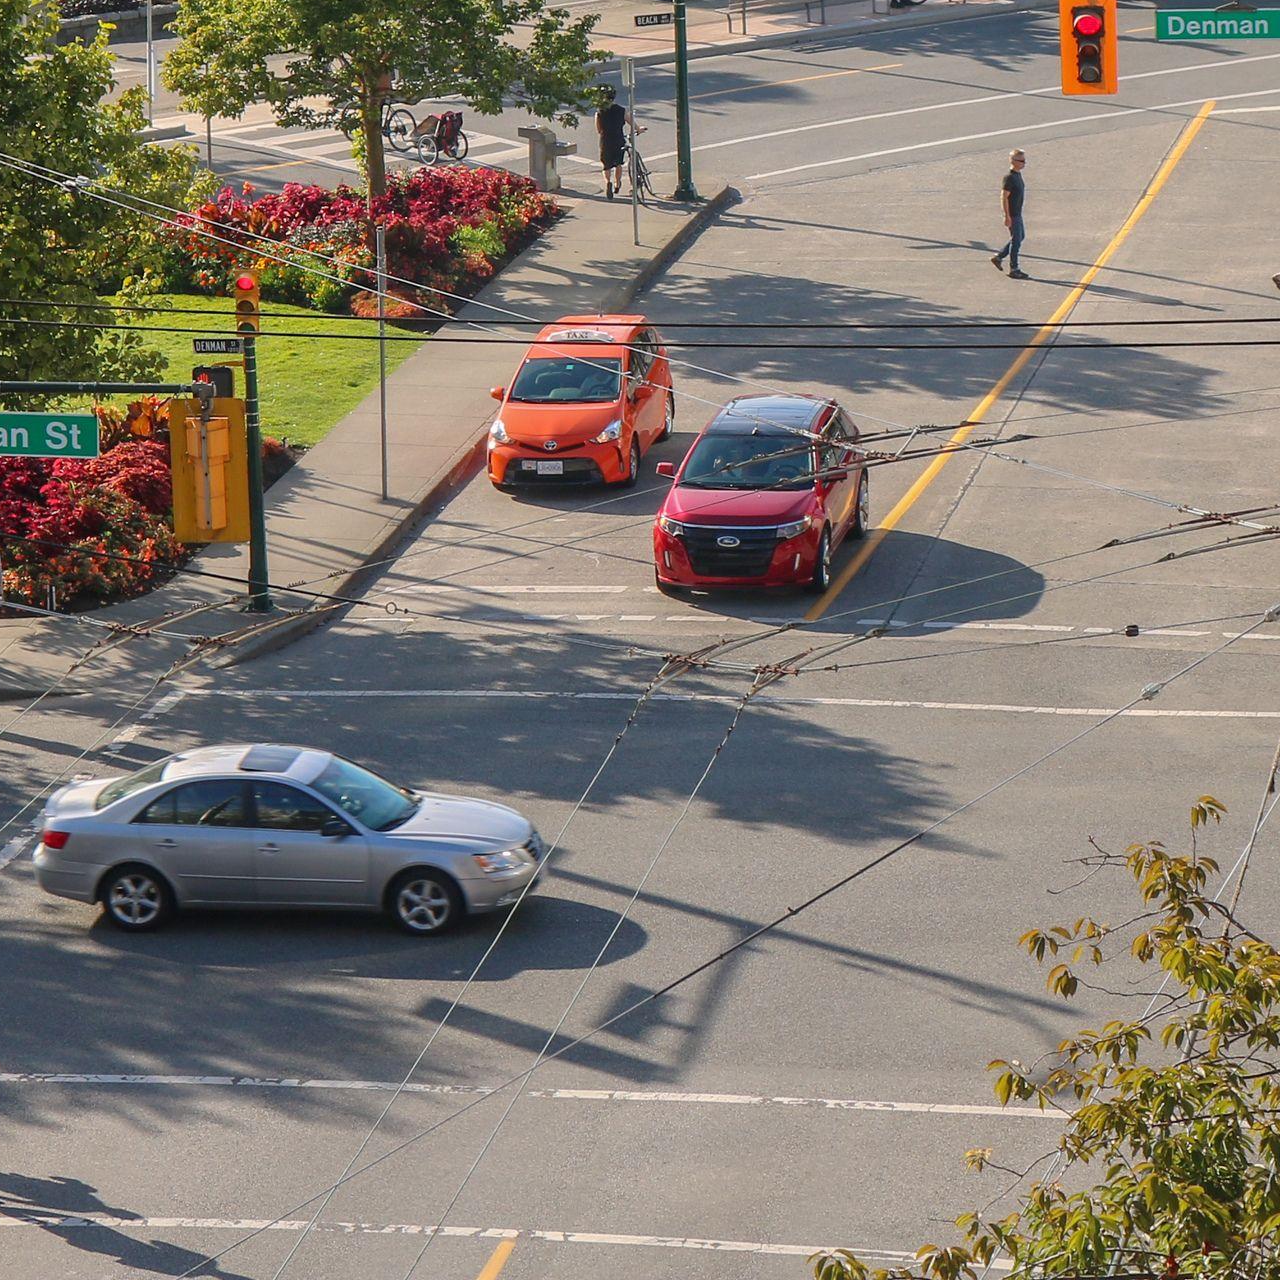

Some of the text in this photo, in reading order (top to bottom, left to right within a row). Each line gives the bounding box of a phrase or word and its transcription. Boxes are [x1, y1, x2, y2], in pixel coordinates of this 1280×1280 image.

[637, 16, 658, 25] BEACH
[1167, 16, 1269, 35] Denman
[195, 340, 226, 351] DENMAN
[45, 421, 82, 450] St
